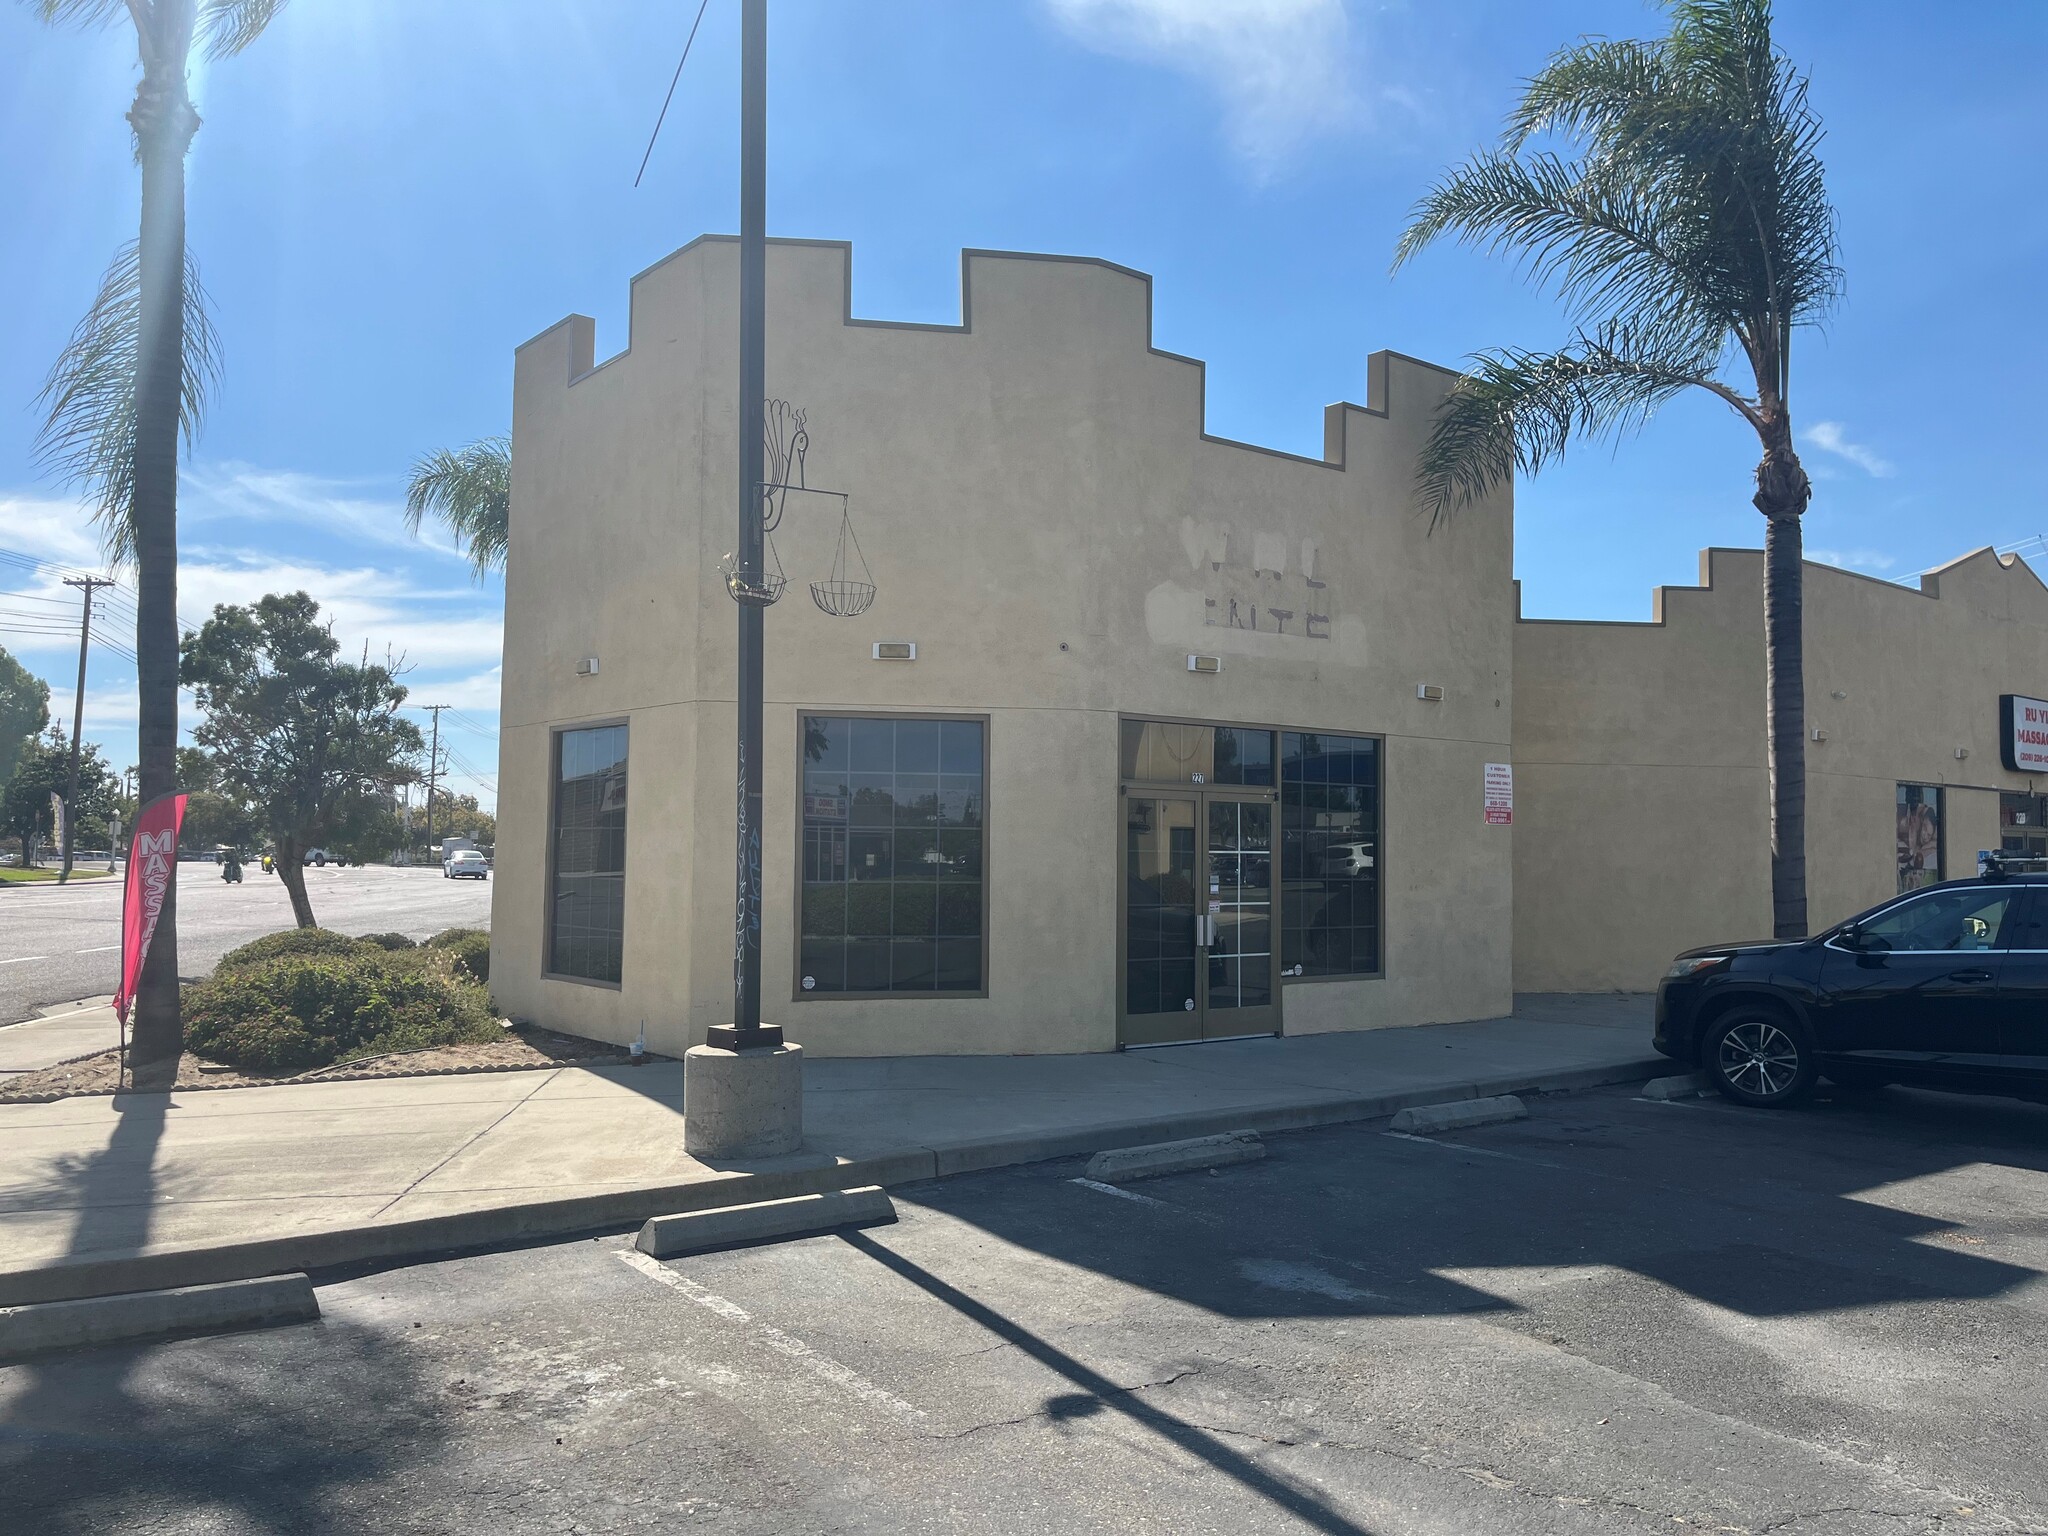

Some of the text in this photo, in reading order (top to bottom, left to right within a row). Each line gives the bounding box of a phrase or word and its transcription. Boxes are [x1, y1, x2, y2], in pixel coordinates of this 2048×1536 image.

[2025, 707, 2037, 722] RU
[1191, 772, 1204, 784] 227
[138, 829, 174, 976] MASS
